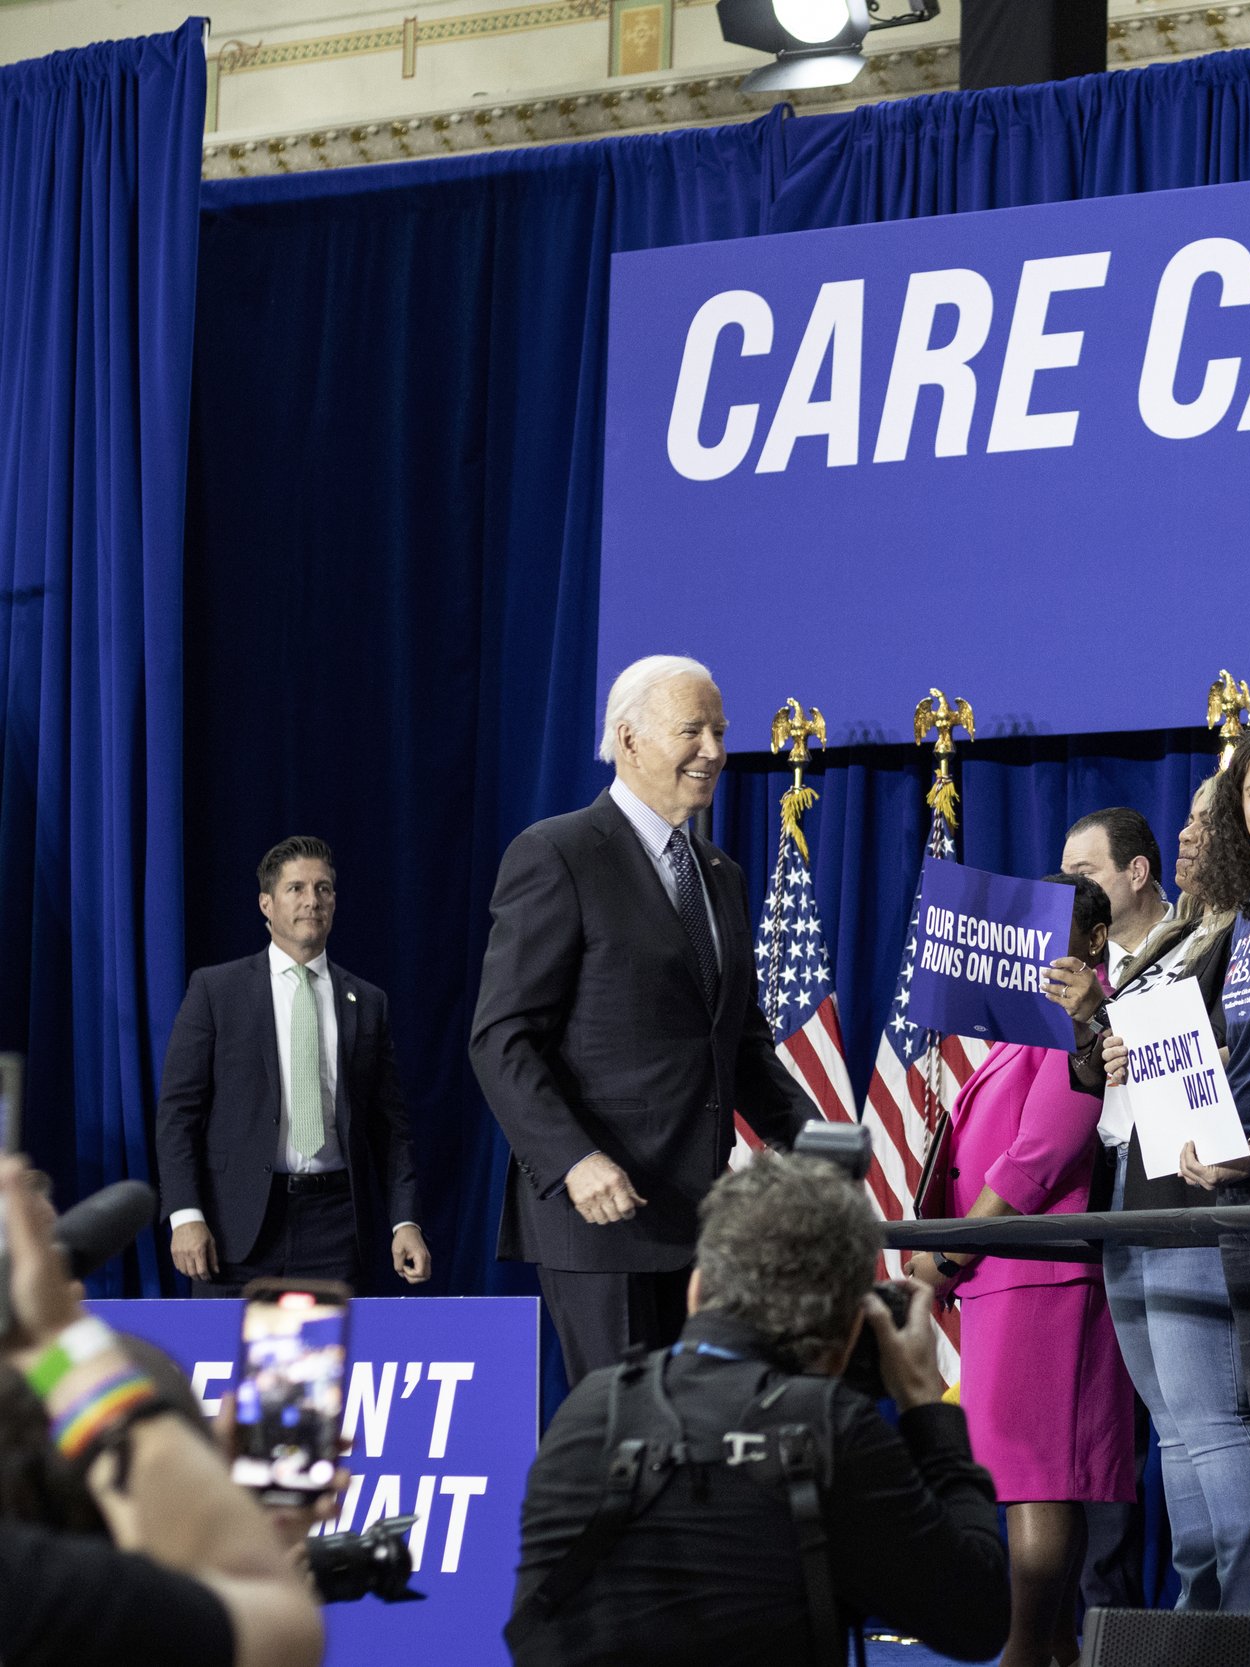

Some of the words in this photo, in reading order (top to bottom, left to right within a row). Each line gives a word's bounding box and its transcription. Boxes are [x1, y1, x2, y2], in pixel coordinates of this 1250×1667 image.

[667, 251, 1112, 481] CARE
[925, 905, 954, 941] OUR
[957, 914, 1053, 961] ECONOMY
[920, 940, 964, 978] RUNS
[966, 952, 993, 985] ON
[1129, 1042, 1165, 1083] CARE
[1163, 1030, 1203, 1073] CAN'T
[1183, 1068, 1218, 1110] WAIT
[338, 1362, 475, 1458] N'T
